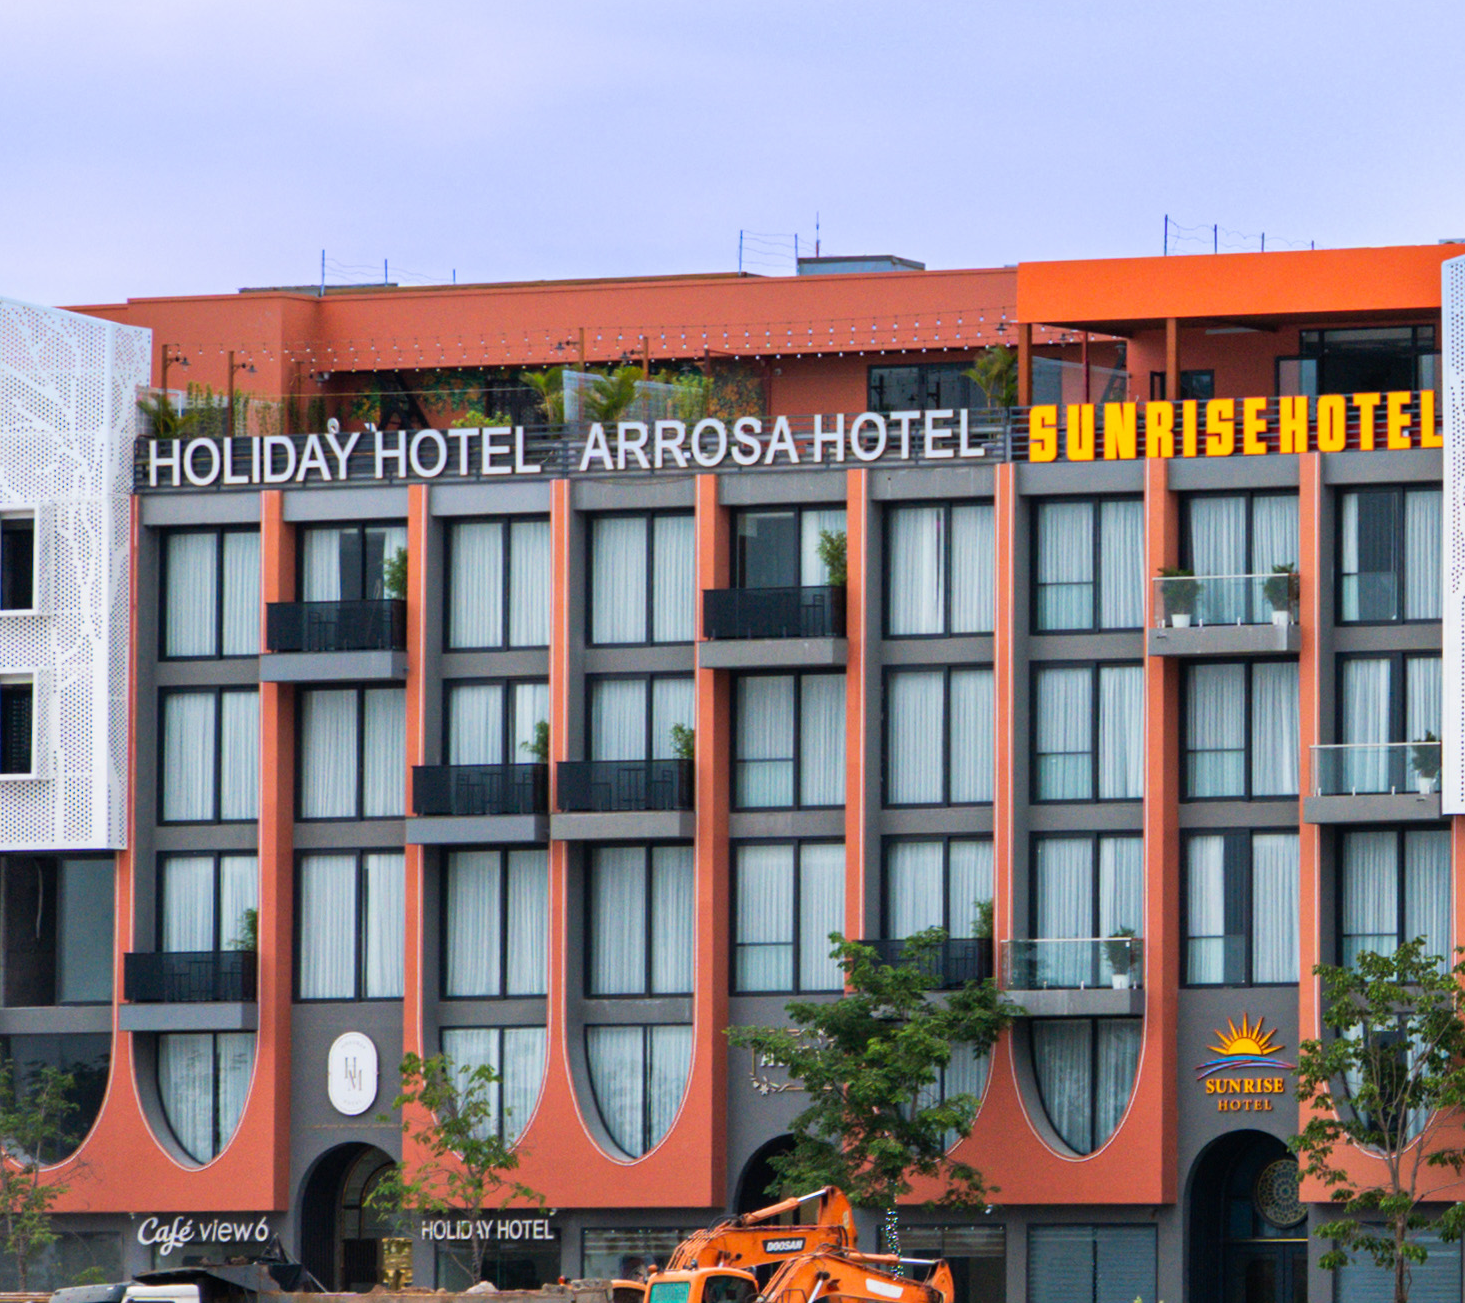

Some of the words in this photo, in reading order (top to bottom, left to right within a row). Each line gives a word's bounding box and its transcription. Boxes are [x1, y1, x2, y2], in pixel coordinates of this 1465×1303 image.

[578, 415, 800, 472] ARROSA
[813, 408, 986, 463] HOTEL
[149, 431, 362, 487] HOLIDAY
[374, 425, 542, 481] HOTEL
[1205, 1078, 1285, 1094] SUNRISE
[1217, 1098, 1273, 1111] HOTEL
[137, 1216, 195, 1256] Café
[497, 1219, 555, 1240] HOTEL
[766, 1239, 804, 1253] DOOSAN
